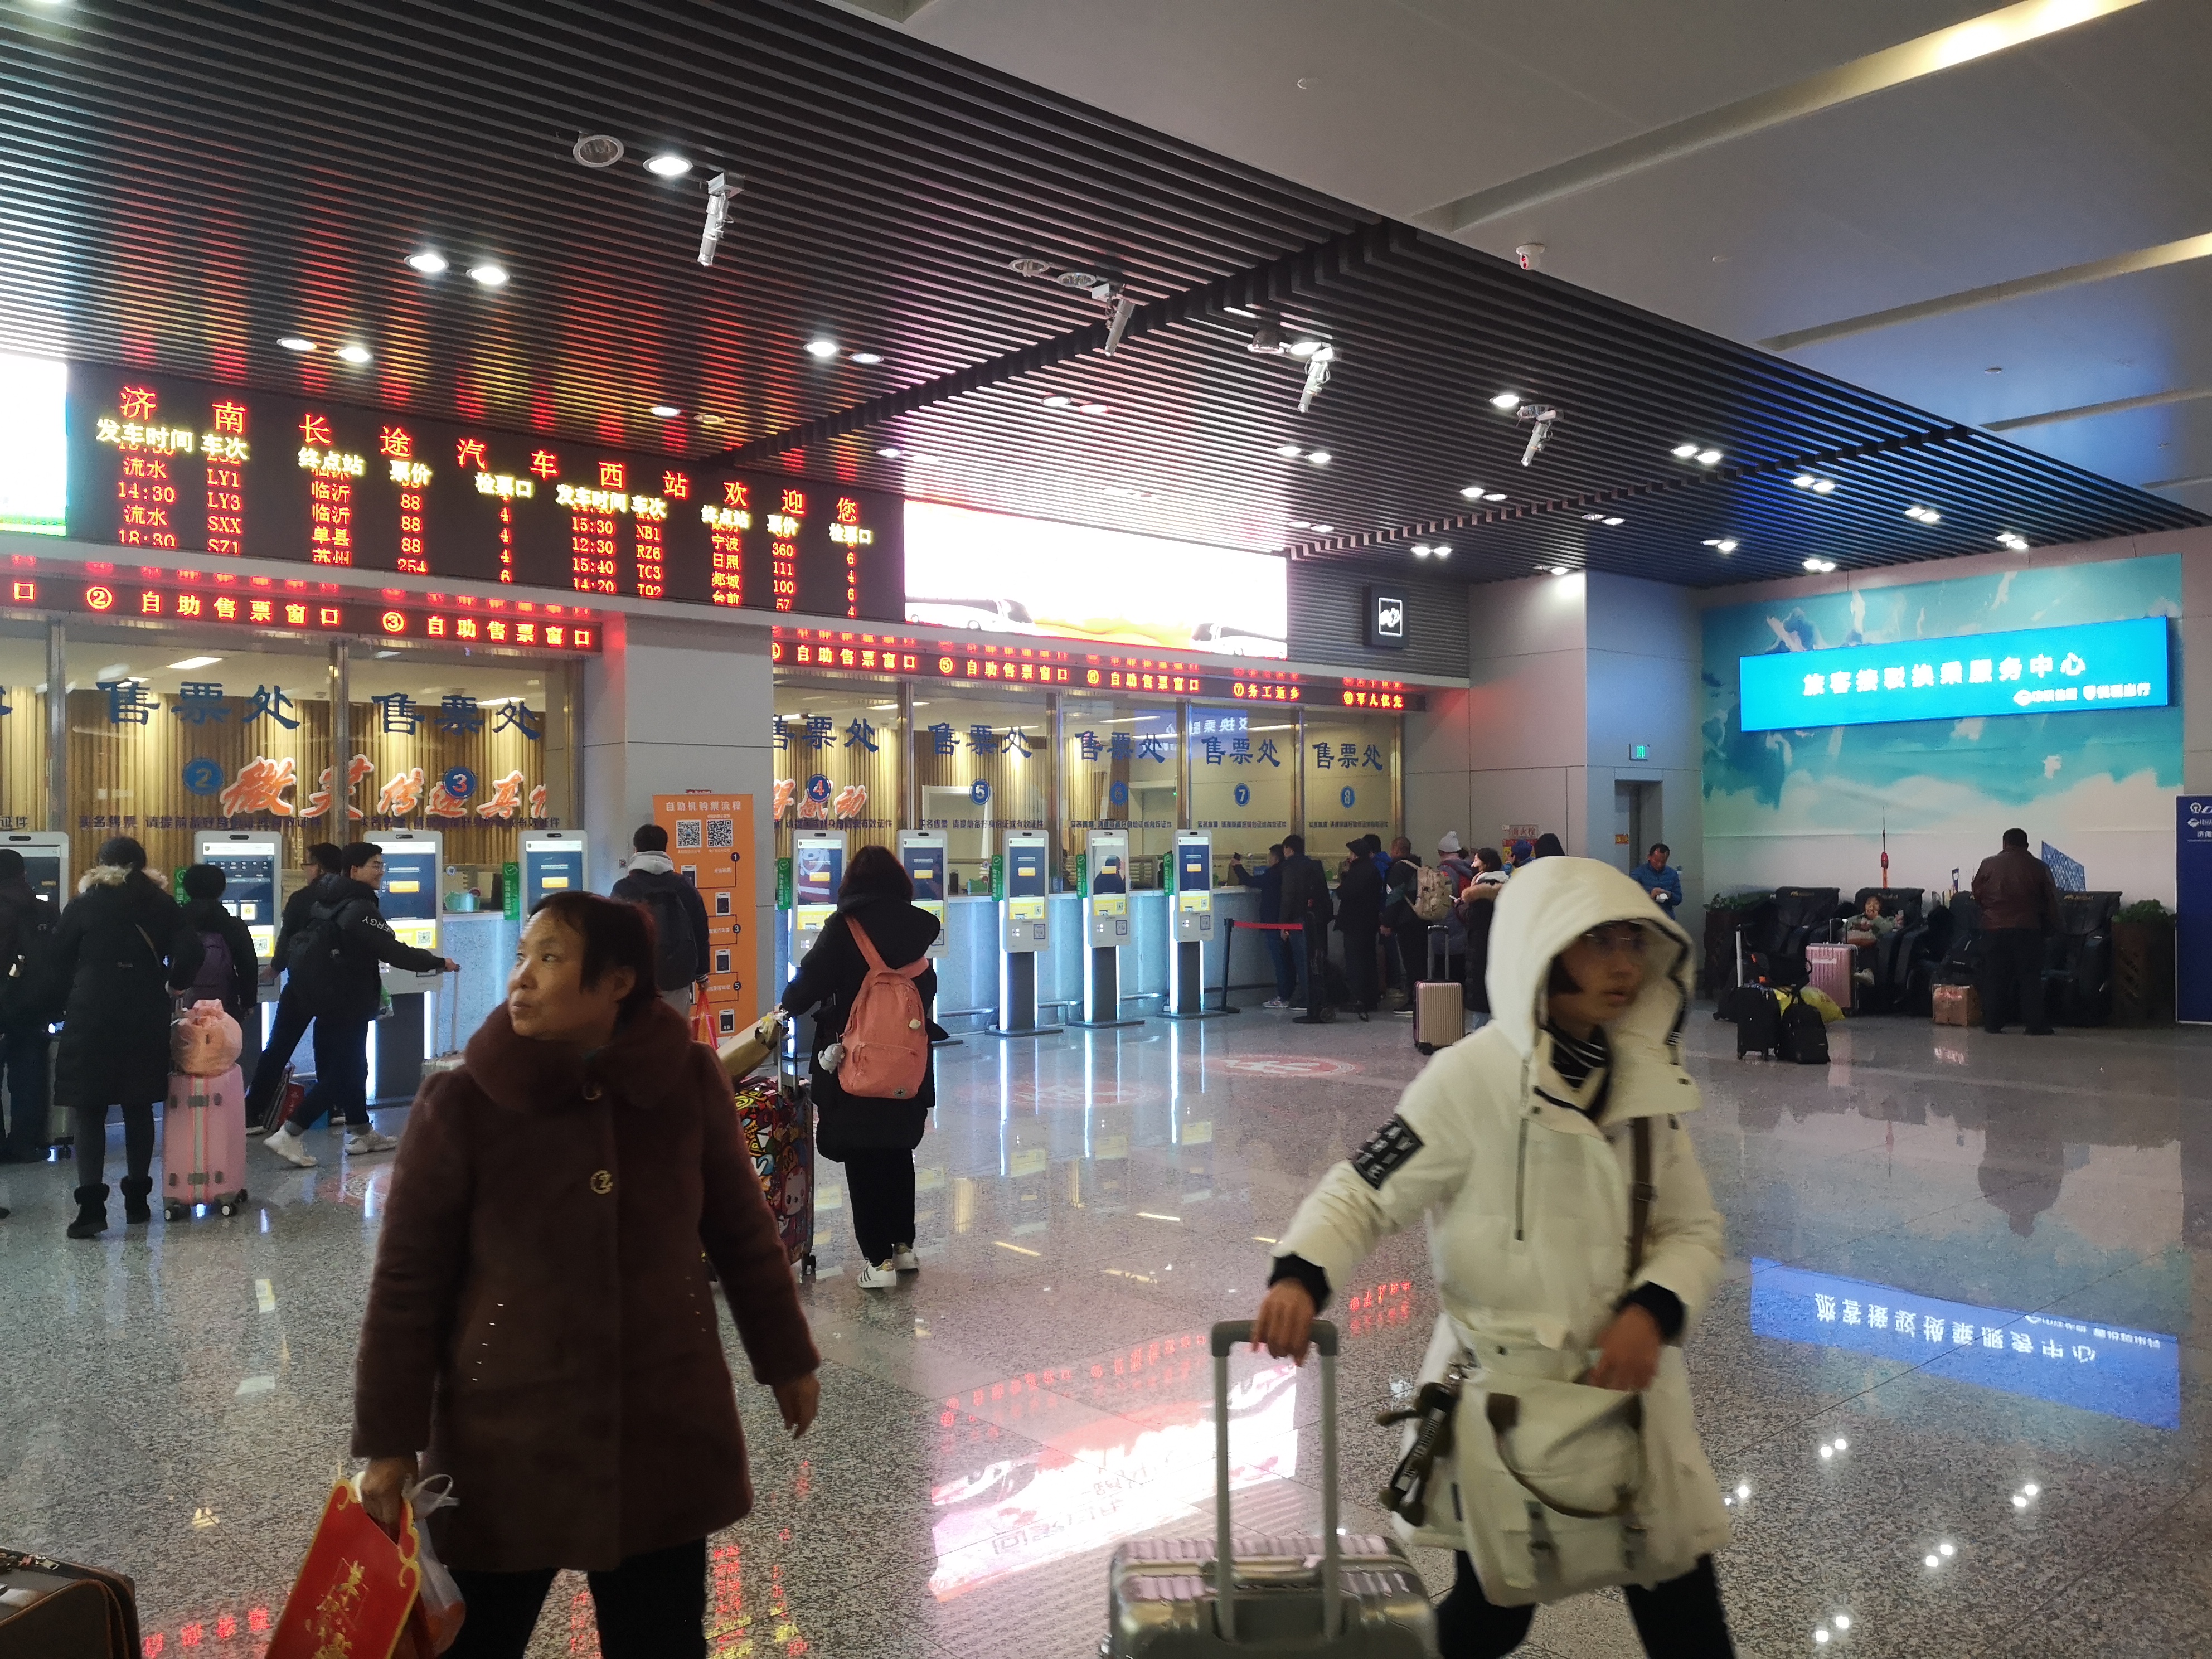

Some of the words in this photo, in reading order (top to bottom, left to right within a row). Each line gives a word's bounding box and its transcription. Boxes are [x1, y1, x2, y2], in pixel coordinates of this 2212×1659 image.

[96, 419, 193, 453] 发车时间
[201, 433, 249, 460] 车次
[298, 447, 365, 476] 终点站
[390, 459, 433, 486] 票价
[474, 472, 533, 498] 检票口
[120, 386, 858, 523] 济南长途汽车西站欢迎您
[118, 481, 176, 503] 14:30
[207, 492, 241, 511] LY3
[312, 504, 351, 525] 临沂
[401, 516, 421, 531] 88
[499, 528, 510, 543] 4
[123, 456, 167, 479] 流水
[207, 468, 240, 488] LY1
[312, 480, 351, 503] 临沂
[400, 494, 421, 510] 88
[499, 508, 510, 522] 4
[123, 504, 168, 527] 流水
[207, 515, 242, 534] SXX
[312, 526, 351, 547] 单县
[401, 537, 421, 553] 88
[500, 549, 510, 564] 4
[556, 484, 628, 513] 发车时间
[631, 495, 667, 518] 车次
[701, 505, 750, 528] 终点站
[830, 523, 873, 544] 检票口
[571, 517, 614, 535] 15:30
[636, 525, 660, 541] NB1
[711, 533, 739, 551] 宁波
[772, 542, 794, 557] 360
[846, 552, 855, 565] 6
[572, 537, 614, 555] 12:30
[636, 545, 661, 561] RZ6
[712, 552, 740, 570] 日照
[773, 561, 793, 576] 111
[847, 570, 855, 583] 4
[573, 557, 614, 575] 15:40
[637, 564, 661, 580] TC3
[773, 580, 794, 594] 100
[847, 588, 855, 601] 6
[95, 677, 300, 729] 售票处
[371, 692, 541, 740] 售票处
[928, 722, 1032, 758] 售票处
[1075, 730, 1165, 763] 售票处
[1201, 736, 1280, 767] 售票处
[1312, 741, 1383, 770] 售票处
[666, 801, 742, 811] 自助机购票流程
